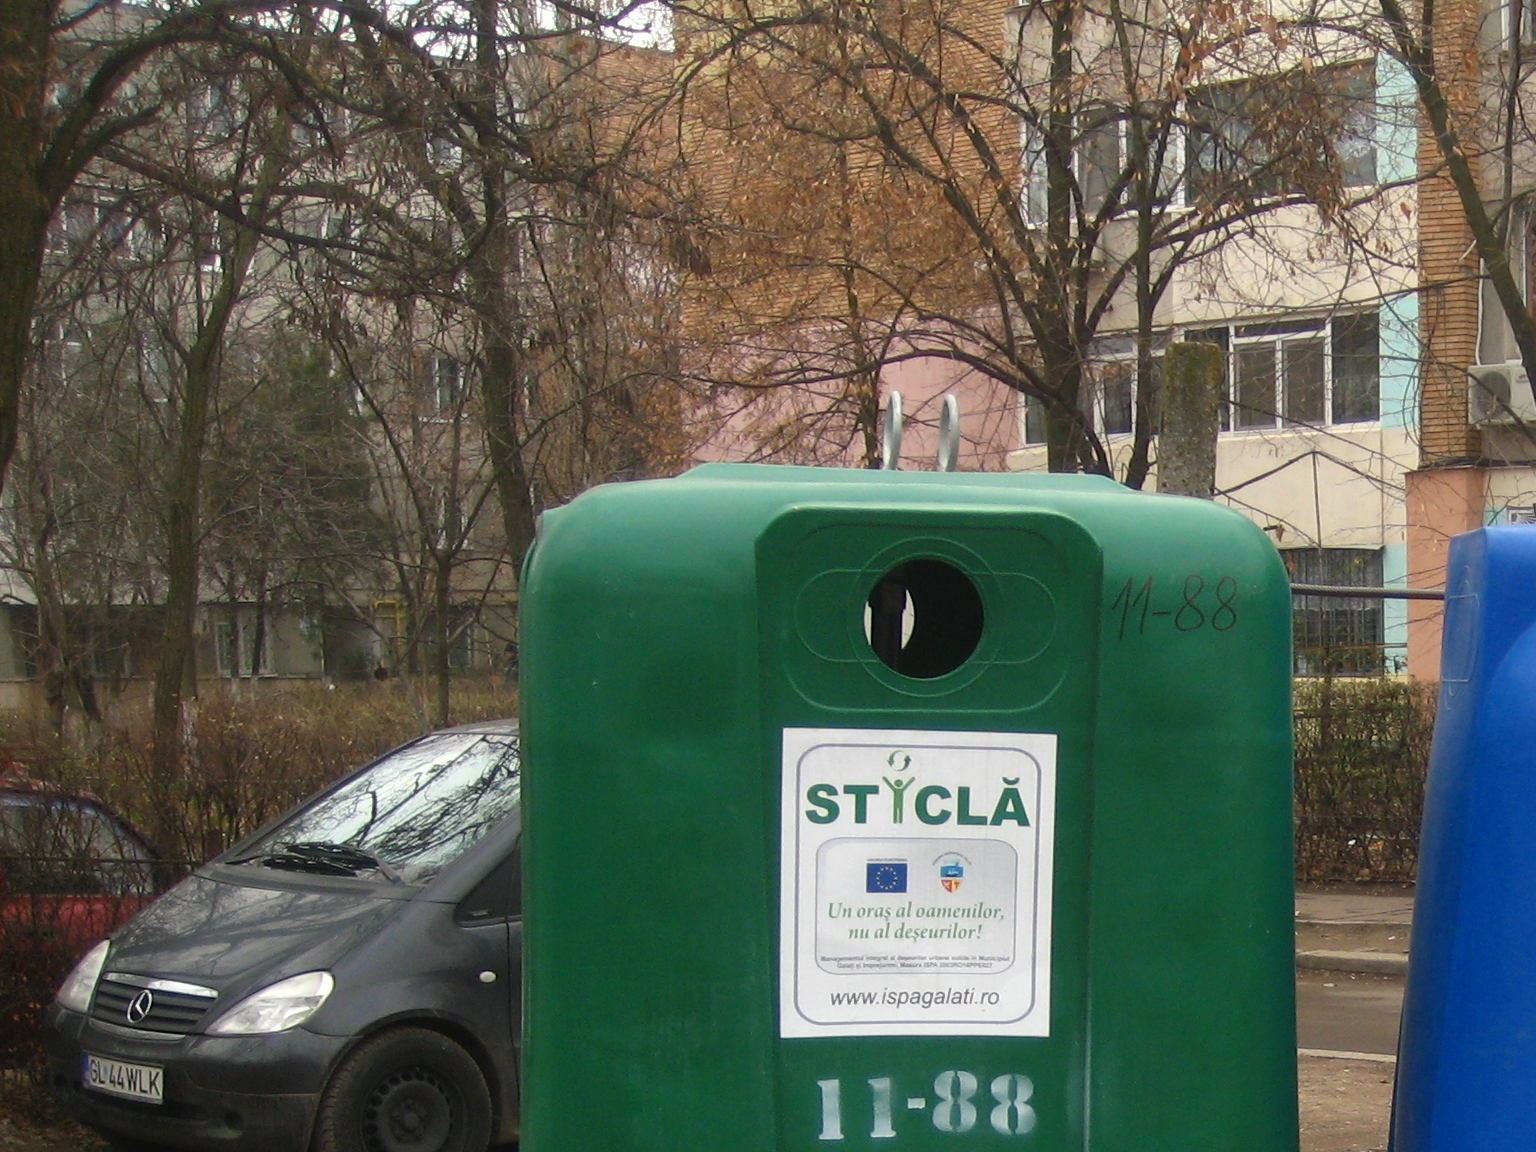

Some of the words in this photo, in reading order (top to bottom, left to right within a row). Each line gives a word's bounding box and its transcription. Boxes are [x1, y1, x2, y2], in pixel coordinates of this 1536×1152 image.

[1111, 574, 1237, 640] 11-88
[805, 775, 1031, 827] STICLĂ
[828, 902, 852, 919] Un
[857, 904, 891, 922] oraş
[895, 901, 913, 919] al
[915, 902, 1005, 921] oamenilor,
[848, 927, 869, 939] nu
[874, 922, 890, 939] al
[894, 922, 983, 943] deşeurilor!
[830, 987, 1000, 1009] www.ispagalati.ro
[90, 1059, 106, 1084] GL
[108, 1064, 124, 1089] 44
[126, 1066, 161, 1095] WLK
[817, 1070, 1037, 1140] 11-88
